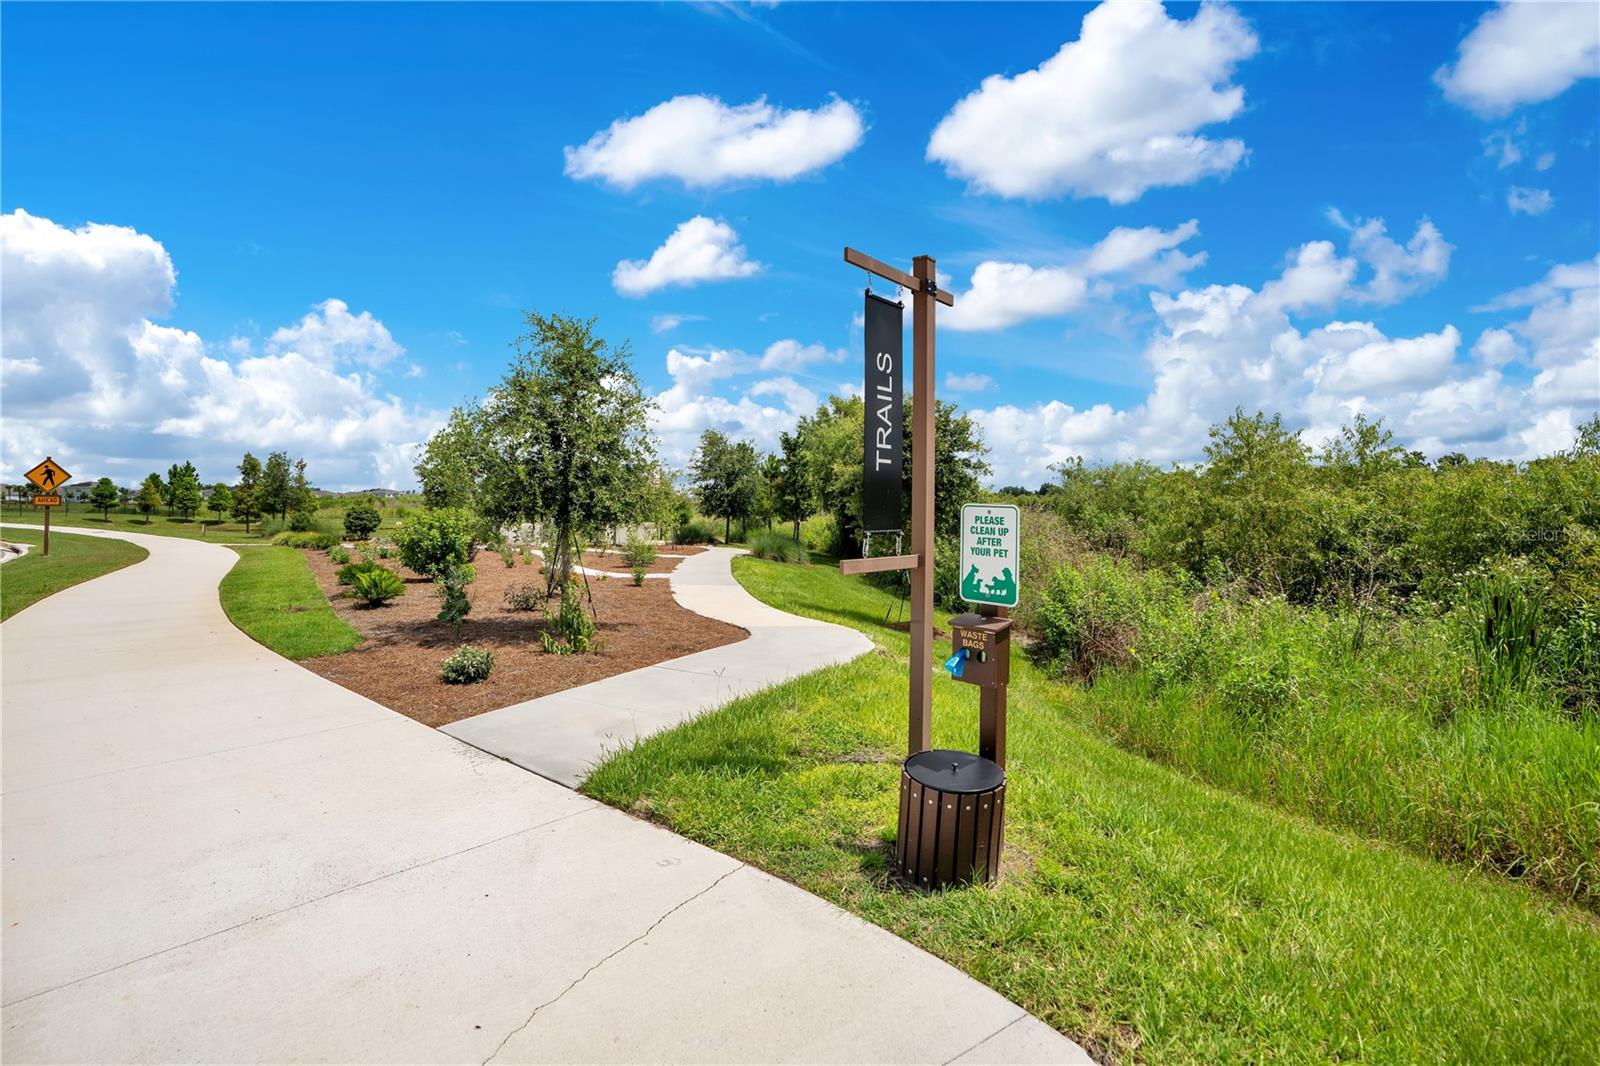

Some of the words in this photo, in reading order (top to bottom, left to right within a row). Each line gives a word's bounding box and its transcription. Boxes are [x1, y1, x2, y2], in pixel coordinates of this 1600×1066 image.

[876, 352, 893, 471] TRAILS
[974, 515, 1005, 526] PLEASE
[970, 525, 996, 536] CLEAN
[998, 527, 1009, 537] UP
[976, 537, 1002, 547] AFTER
[970, 547, 991, 557] YOUR
[993, 549, 1009, 558] PET
[960, 629, 988, 641] WASTE
[962, 639, 985, 650] BAGS
